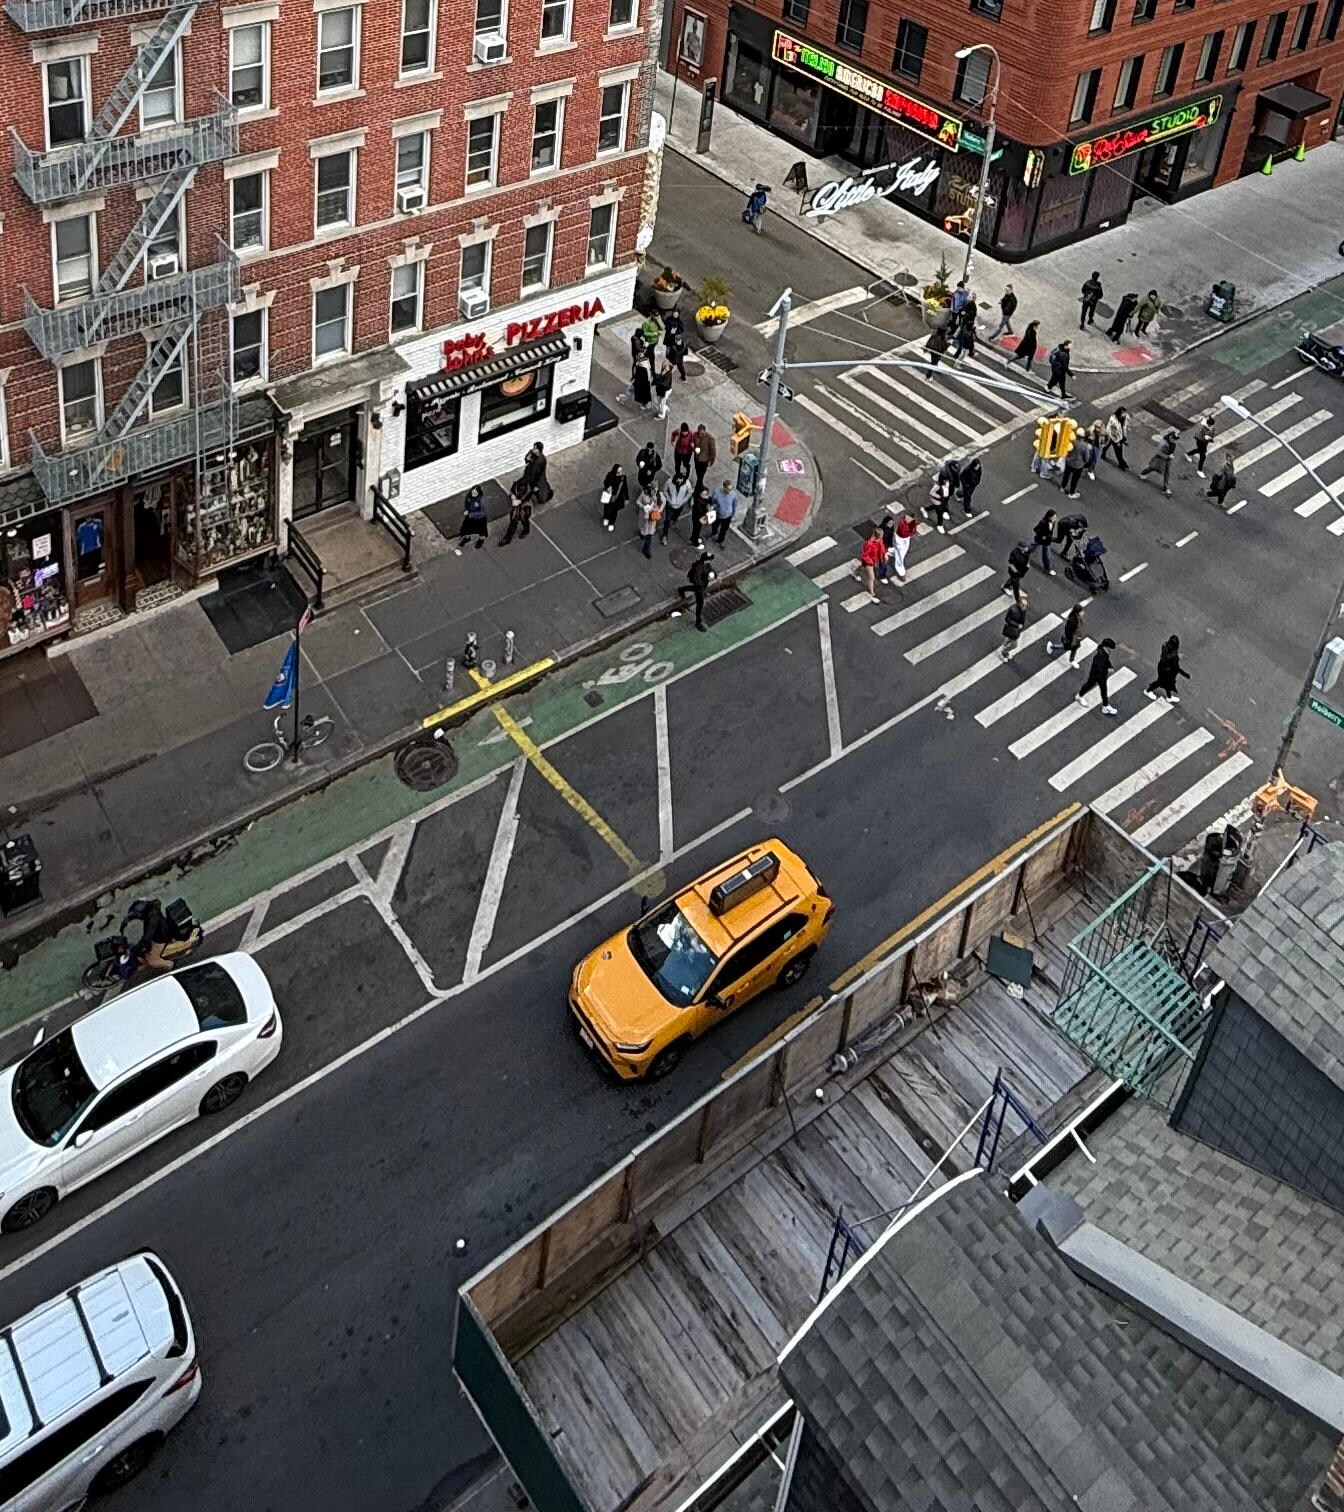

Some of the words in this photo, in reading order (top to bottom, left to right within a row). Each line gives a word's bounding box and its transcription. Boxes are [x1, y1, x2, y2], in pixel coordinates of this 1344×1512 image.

[1150, 106, 1200, 135] STUDIO
[806, 177, 875, 217] Little
[876, 156, 941, 197] Italy
[507, 297, 605, 346] PIZZERIA
[443, 331, 486, 355] Baby
[1310, 701, 1343, 726] Mulberry
